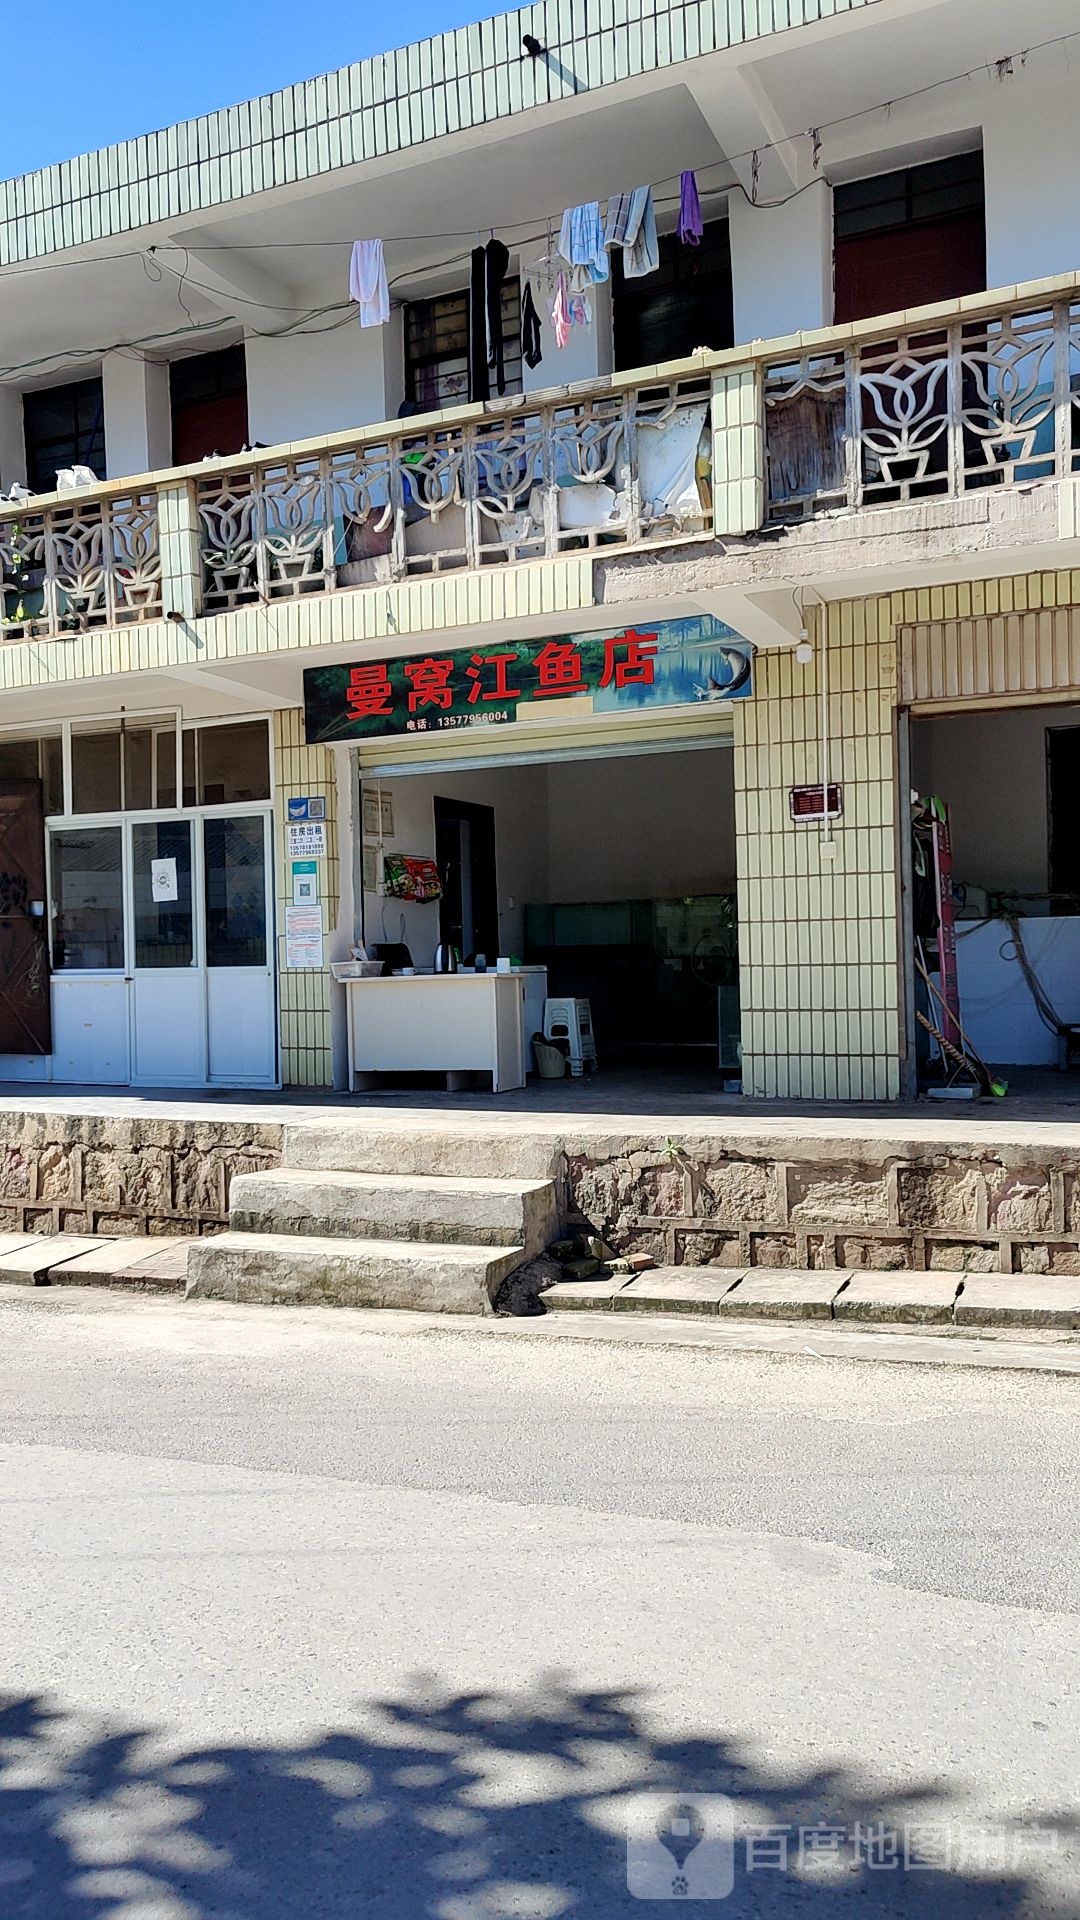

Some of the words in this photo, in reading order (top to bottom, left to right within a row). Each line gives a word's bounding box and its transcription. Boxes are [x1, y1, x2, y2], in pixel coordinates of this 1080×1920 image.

[345, 629, 659, 720] 曼窝江鱼店
[290, 825, 322, 837] 住房出租
